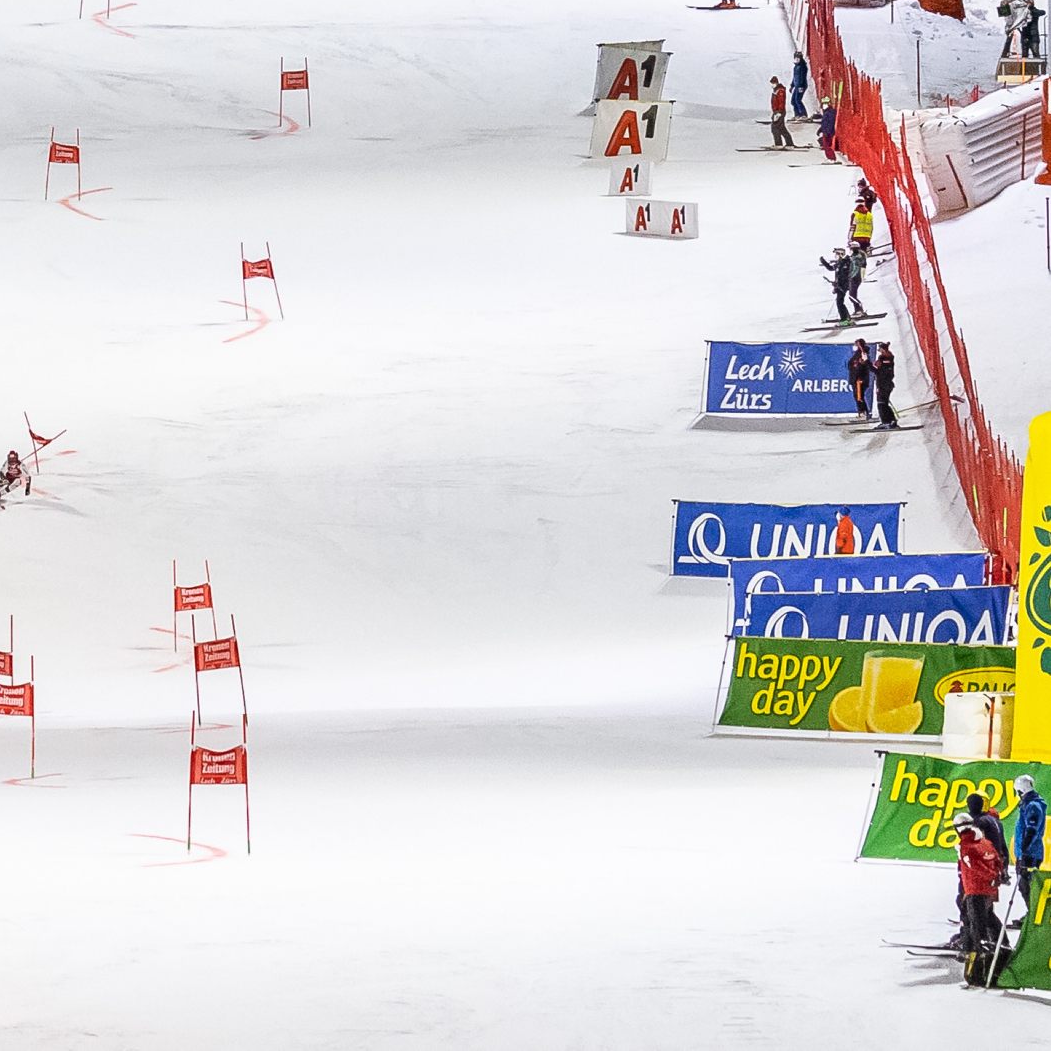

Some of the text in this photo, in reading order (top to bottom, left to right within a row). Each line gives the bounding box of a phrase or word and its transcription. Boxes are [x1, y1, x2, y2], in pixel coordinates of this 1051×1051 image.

[608, 54, 656, 100] A1
[604, 104, 658, 156] A1
[619, 163, 640, 193] A1
[634, 202, 686, 234] A1 A1
[725, 355, 774, 380] Lech
[720, 384, 772, 410] Zürs
[736, 643, 843, 691] happy
[751, 683, 818, 726] day
[202, 762, 235, 774] Zeitung
[909, 810, 960, 848] da
